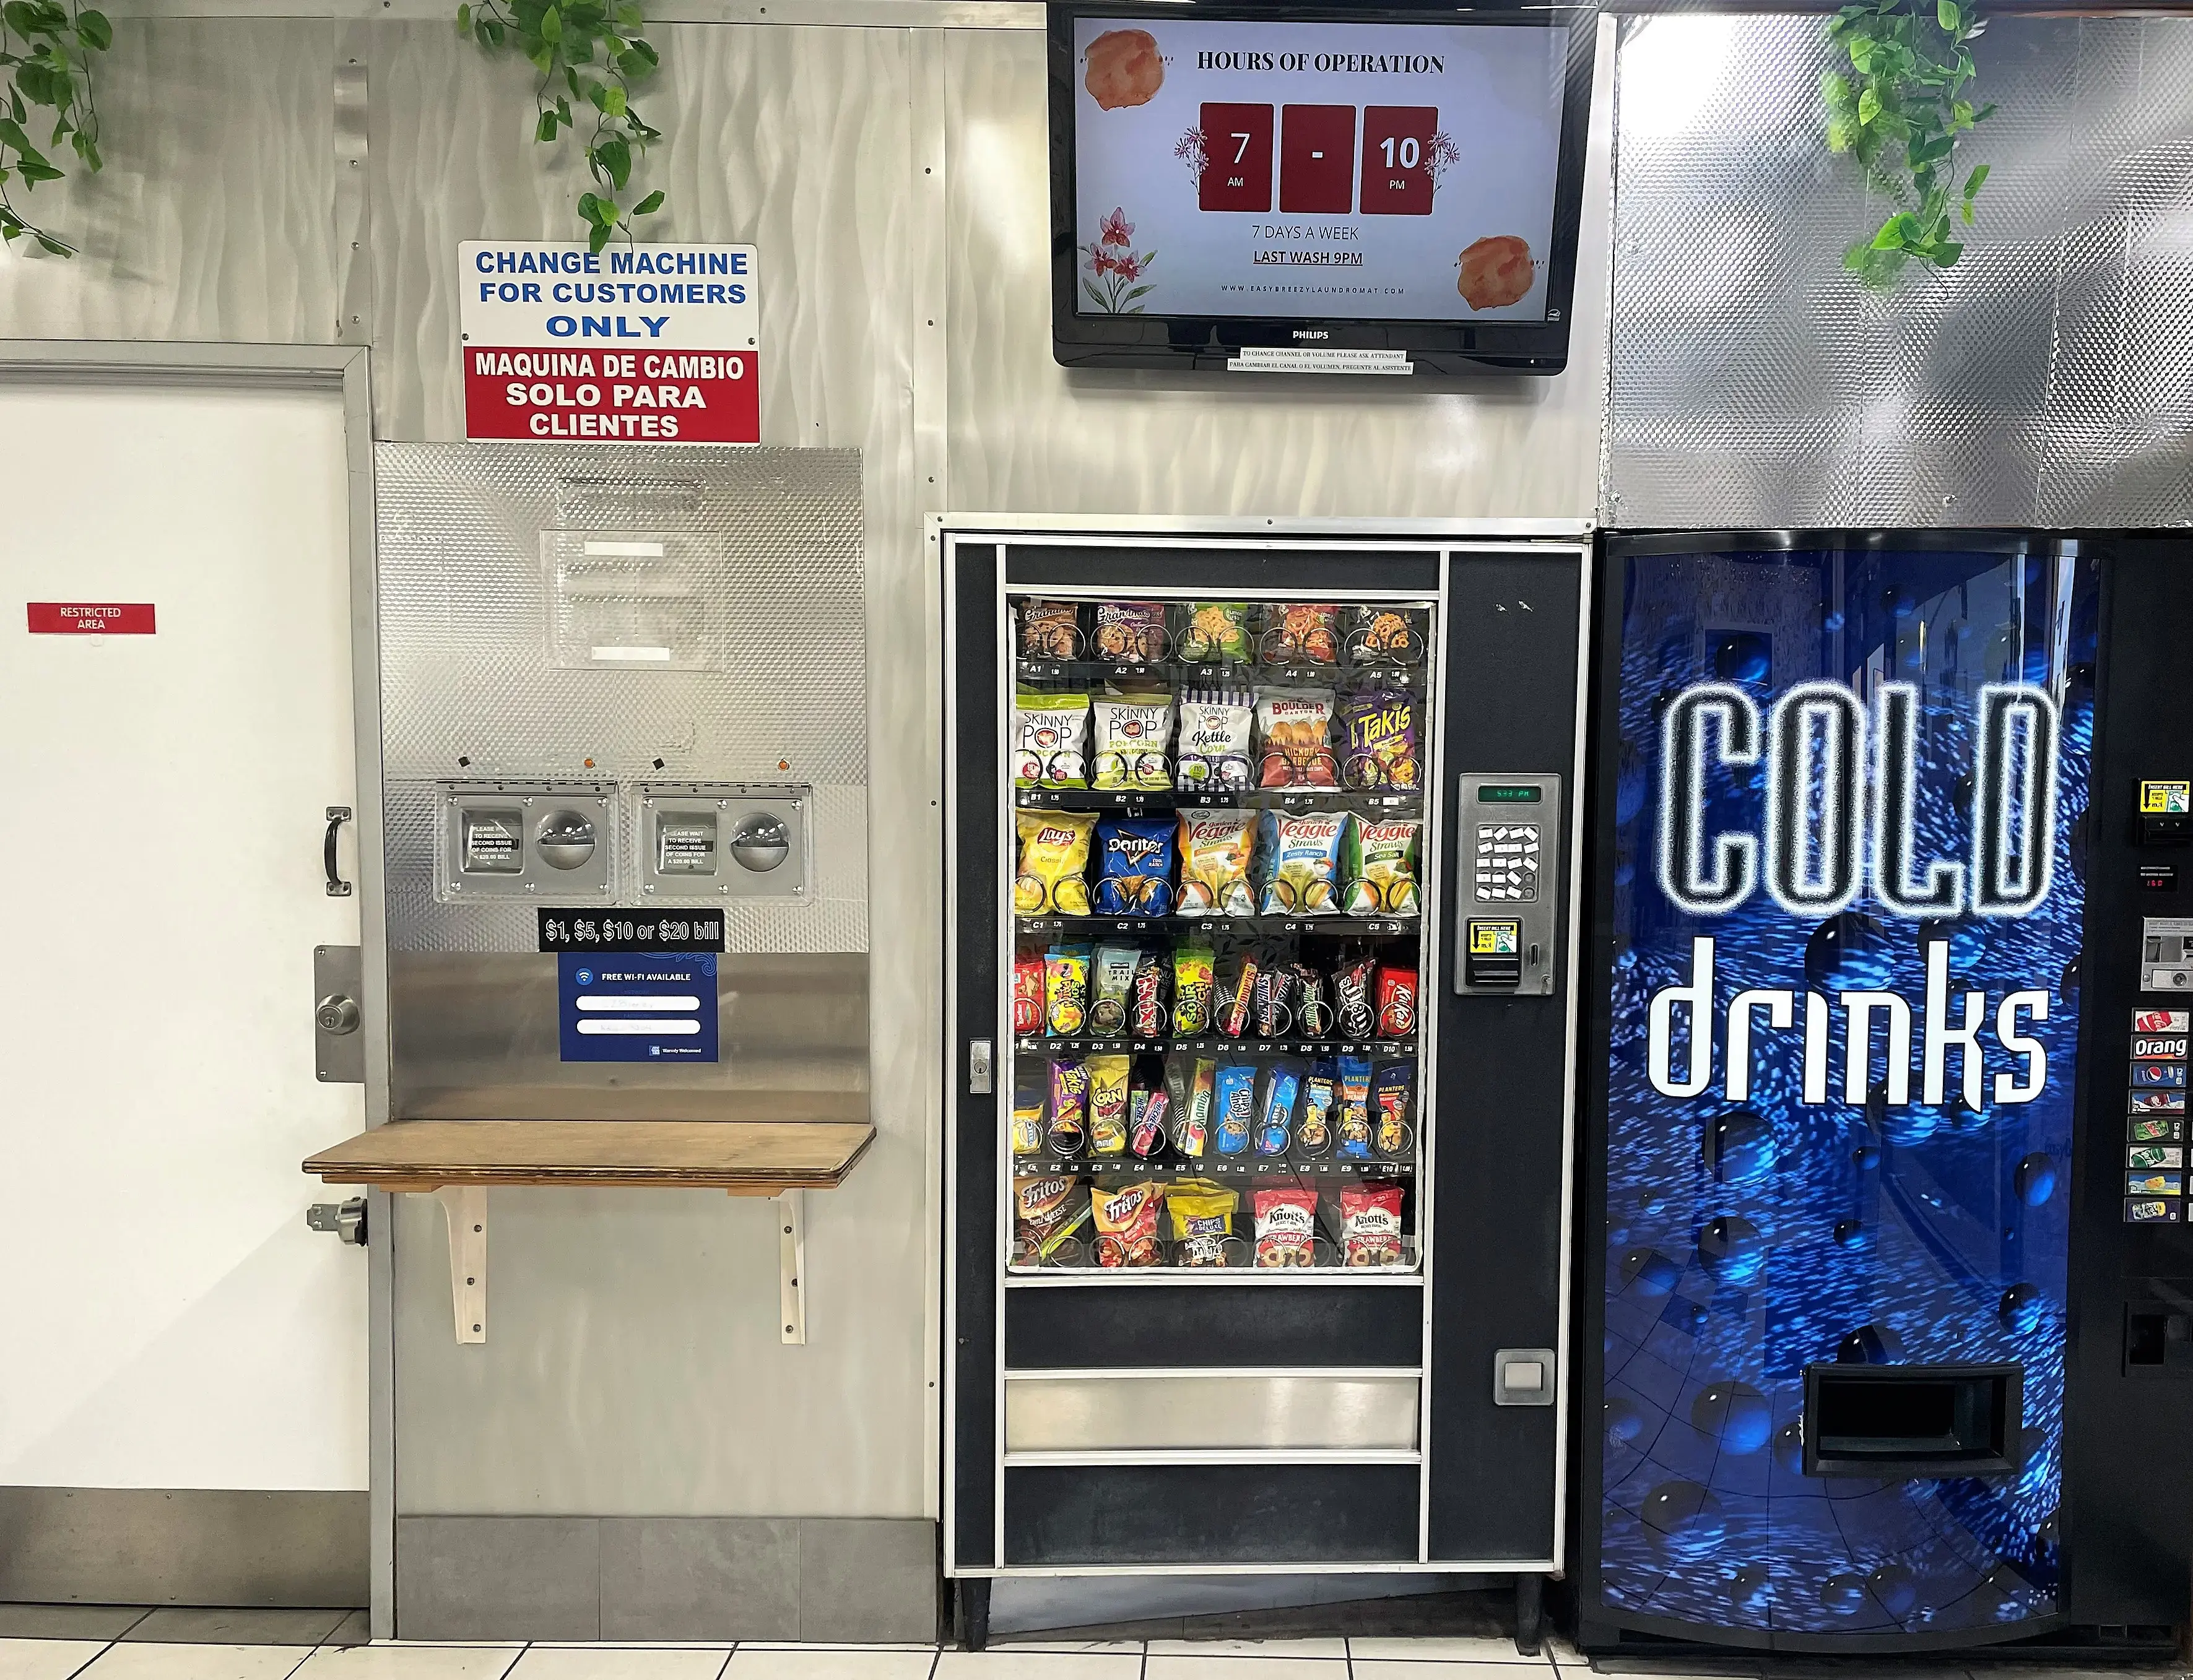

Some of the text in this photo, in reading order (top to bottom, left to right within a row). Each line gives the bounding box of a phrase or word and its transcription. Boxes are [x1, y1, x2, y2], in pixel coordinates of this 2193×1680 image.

[1197, 51, 1445, 74] HOURS OF OPERATION
[1231, 132, 1250, 164] 7
[1379, 136, 1420, 169] 10
[1227, 176, 1244, 187] AM
[1389, 180, 1405, 190] PM
[1252, 225, 1359, 240] 7 DAYS A WEEK
[476, 251, 749, 275] CHANGE MACHINE
[1254, 250, 1363, 266] LAST WASH 9PM
[480, 283, 747, 304] FOR CUSTOMERS
[546, 316, 670, 337] ONLY
[1293, 331, 1329, 339] PHILIPS
[476, 352, 744, 380] MAQUINA DE CAMBIO
[506, 383, 707, 409] SOLO PARA
[529, 414, 679, 437] CLIENTES
[60, 607, 121, 618] RESTRICTED
[77, 619, 106, 630] AREA
[1110, 706, 1158, 720] SKINNY
[1199, 706, 1230, 716] SKINNY
[1272, 702, 1325, 716] BOULDER
[1024, 713, 1073, 727] SKINNY
[1110, 719, 1157, 740] POP
[1198, 716, 1228, 730] POP
[1358, 705, 1410, 748] Takis
[1023, 725, 1072, 748] POP
[1192, 730, 1231, 746] Kettle
[1200, 744, 1227, 754] Corn
[1284, 747, 1320, 756] HICKORY
[1659, 681, 2059, 916] COLD
[1188, 821, 1246, 842] Veggie
[1278, 819, 1337, 839] Veggie
[1359, 822, 1417, 844] Veggie
[1108, 838, 1164, 854] Doritos
[1288, 839, 1323, 847] Straws
[1370, 840, 1404, 852] Straws
[545, 919, 719, 943] $1, $5, $10 or $20 bill
[1185, 984, 1197, 1021] SOUR
[1648, 936, 2049, 1112] drinks
[2136, 1039, 2187, 1056] Orang
[1062, 1068, 1082, 1095] Takis
[1308, 1076, 1333, 1085] PLANTERS
[1092, 1088, 1123, 1107] CORN
[1136, 1098, 1144, 1122] HI-CHE
[1147, 1101, 1164, 1132] HI-CHEW
[1022, 1177, 1066, 1208] Fritos
[1104, 1190, 1143, 1222] Fritos
[1197, 1218, 1220, 1227] CHIPS
[1269, 1208, 1305, 1224] Knott's
[1355, 1215, 1389, 1227] Knott's
